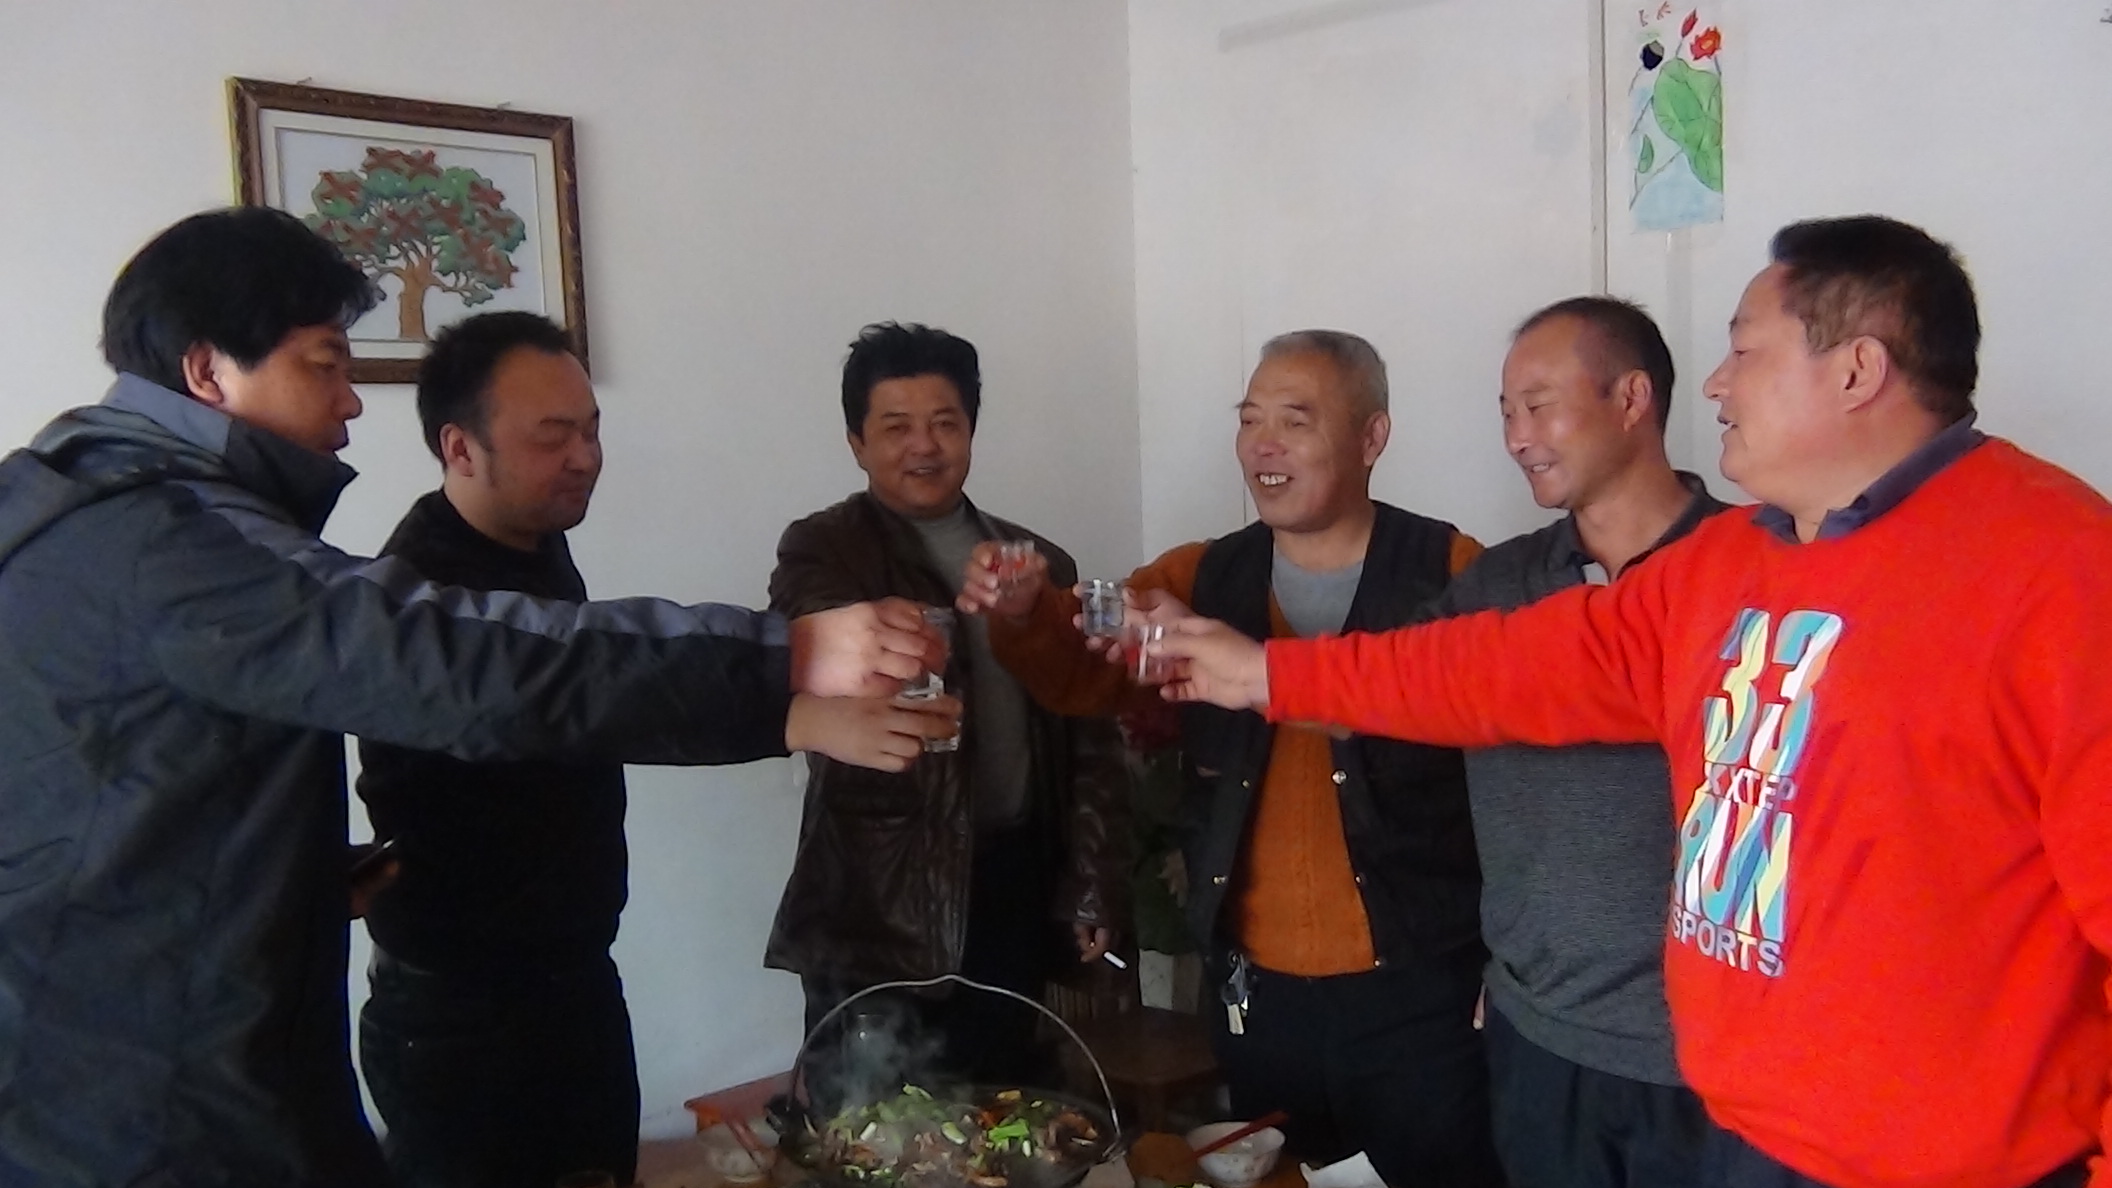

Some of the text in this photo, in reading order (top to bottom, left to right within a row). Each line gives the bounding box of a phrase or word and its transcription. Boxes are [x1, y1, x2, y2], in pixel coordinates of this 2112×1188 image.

[1704, 608, 1843, 774] 33
[1672, 904, 1783, 977] SPORTS
[1674, 792, 1793, 943] RUN
